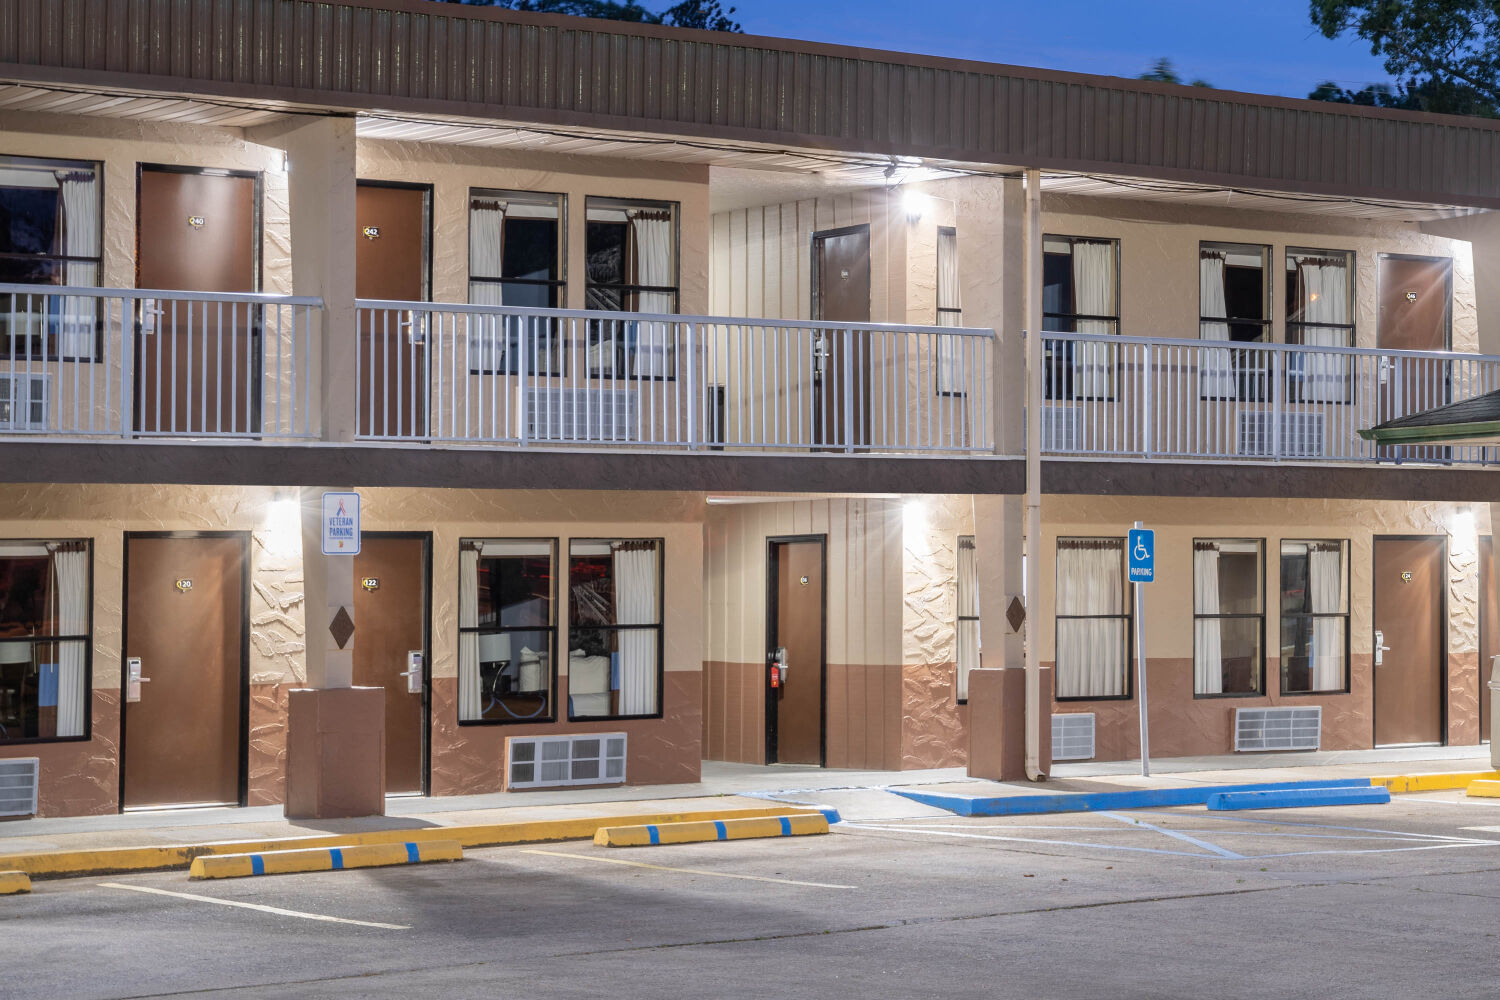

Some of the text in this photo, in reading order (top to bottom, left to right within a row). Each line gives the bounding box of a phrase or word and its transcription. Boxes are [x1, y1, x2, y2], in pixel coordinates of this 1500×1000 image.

[328, 517, 354, 526] VETERAN
[329, 527, 354, 537] PARKING
[1131, 568, 1152, 576] PARKING
